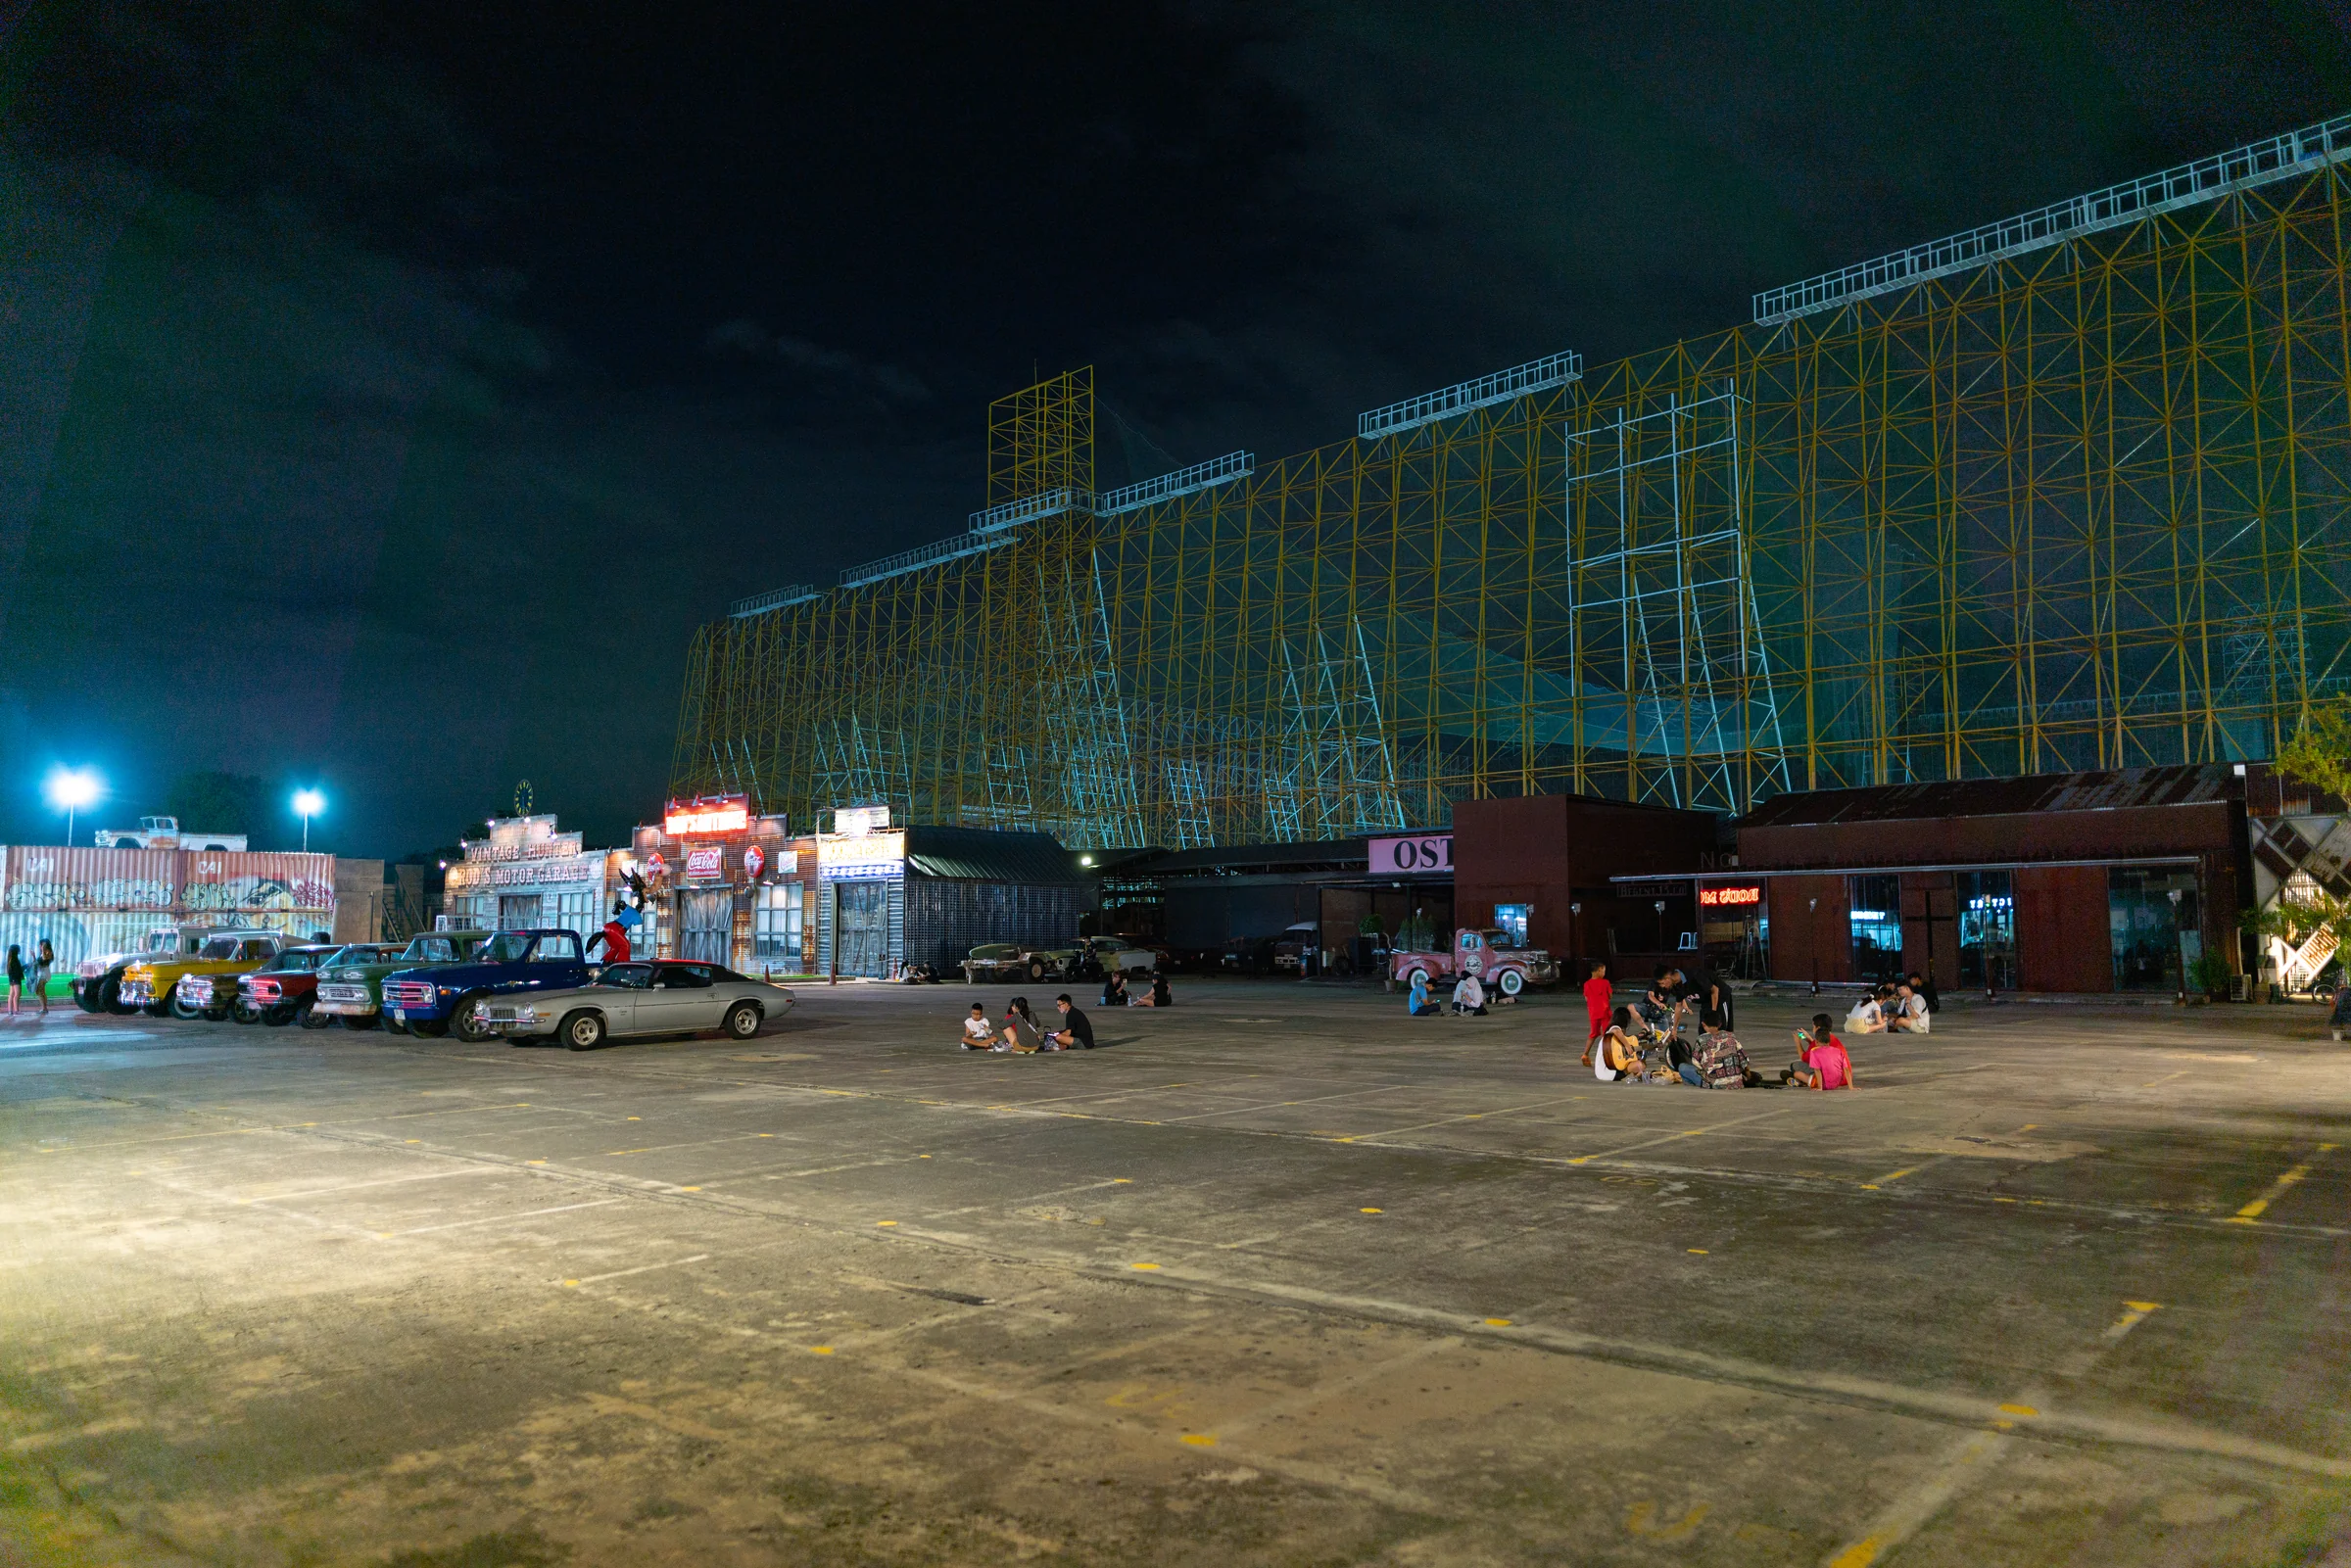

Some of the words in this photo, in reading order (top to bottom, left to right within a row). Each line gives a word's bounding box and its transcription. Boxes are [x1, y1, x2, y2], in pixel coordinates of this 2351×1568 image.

[470, 845, 520, 863] VINTAGE
[527, 841, 577, 859] HUNTER
[1393, 837, 1454, 870] OST
[198, 861, 222, 875] CAI
[458, 867, 490, 888] ROD'S
[495, 868, 534, 885] MOTOR
[539, 864, 588, 883] GARAGE
